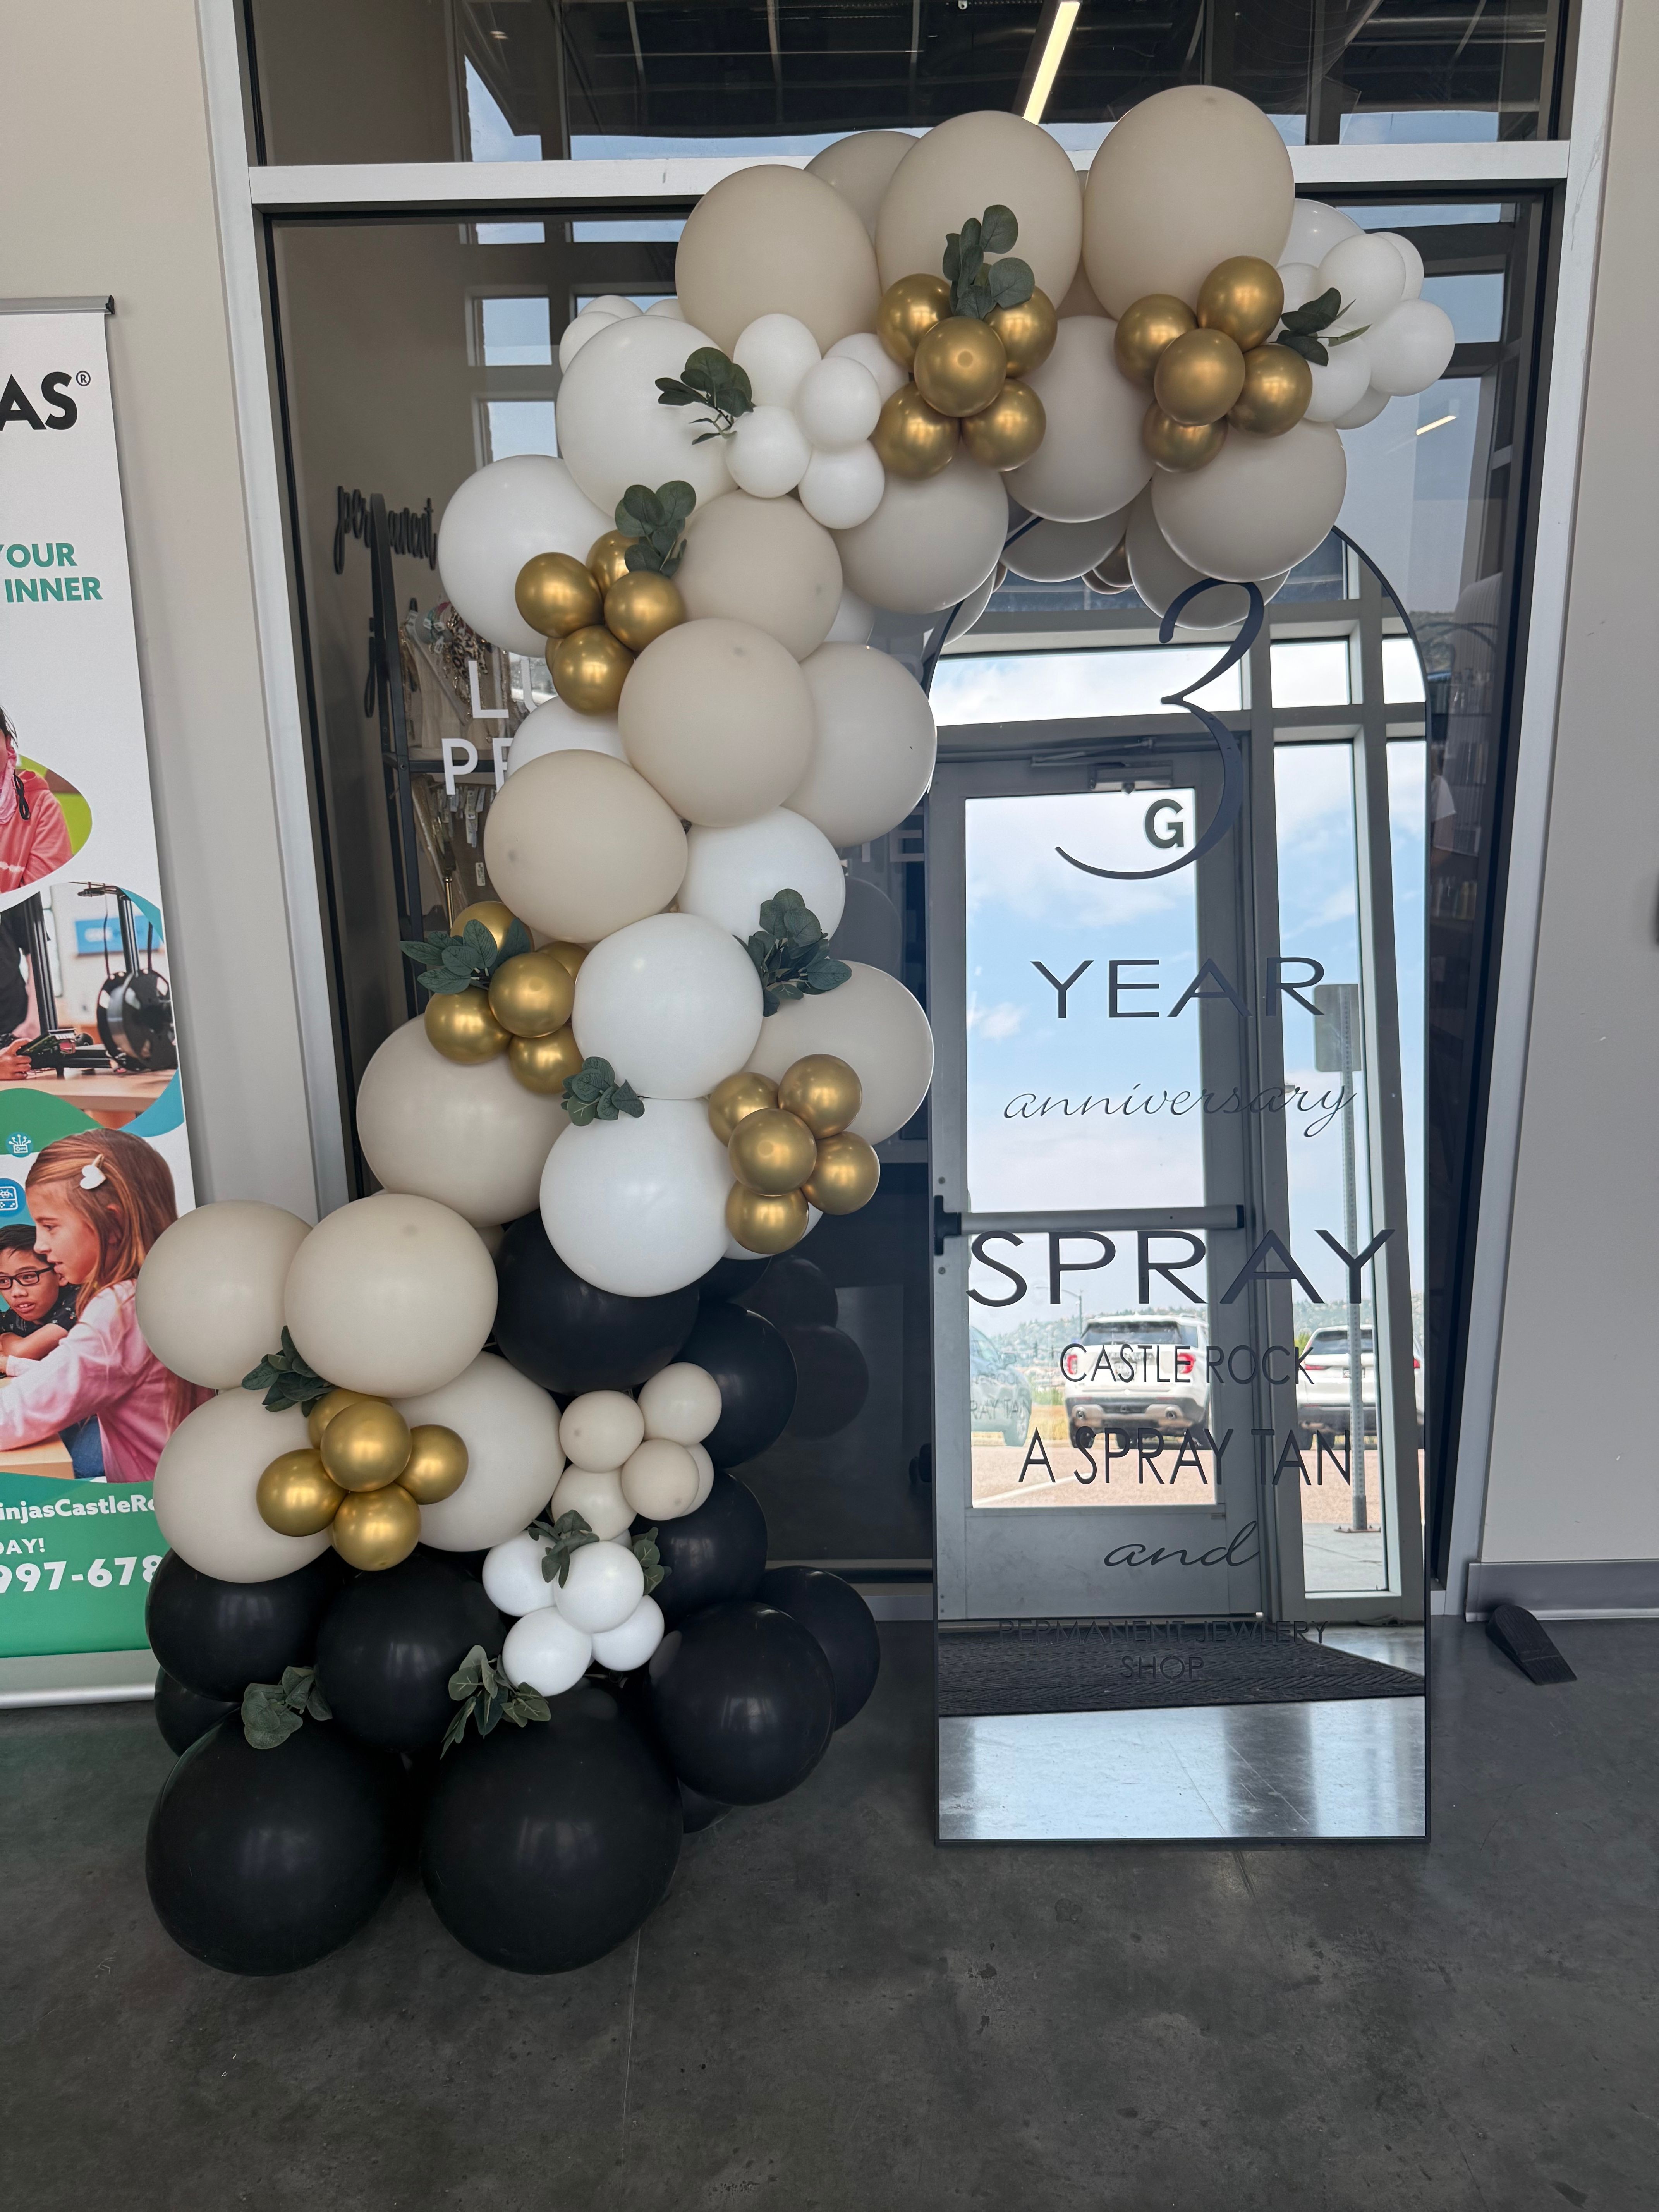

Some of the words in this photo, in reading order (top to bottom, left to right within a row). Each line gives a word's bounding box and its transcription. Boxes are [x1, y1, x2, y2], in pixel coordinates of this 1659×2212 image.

[0, 543, 78, 568] OUR
[5, 577, 104, 603] INNER
[1055, 578, 1264, 880] 3
[1144, 799, 1184, 848] G
[1030, 957, 1325, 1018] YEAR
[1004, 1083, 1357, 1137] anniversary
[966, 1229, 1396, 1307] SPRAY
[1060, 1343, 1191, 1383] CASTLE
[1206, 1345, 1315, 1385] ROCK
[1018, 1427, 1056, 1483] A
[1073, 1425, 1234, 1485] SPRAY
[1251, 1428, 1350, 1486] TAN
[1103, 1520, 1260, 1567] and
[998, 1620, 1186, 1644] PERMANENT
[1120, 1656, 1204, 1680] SHOP
